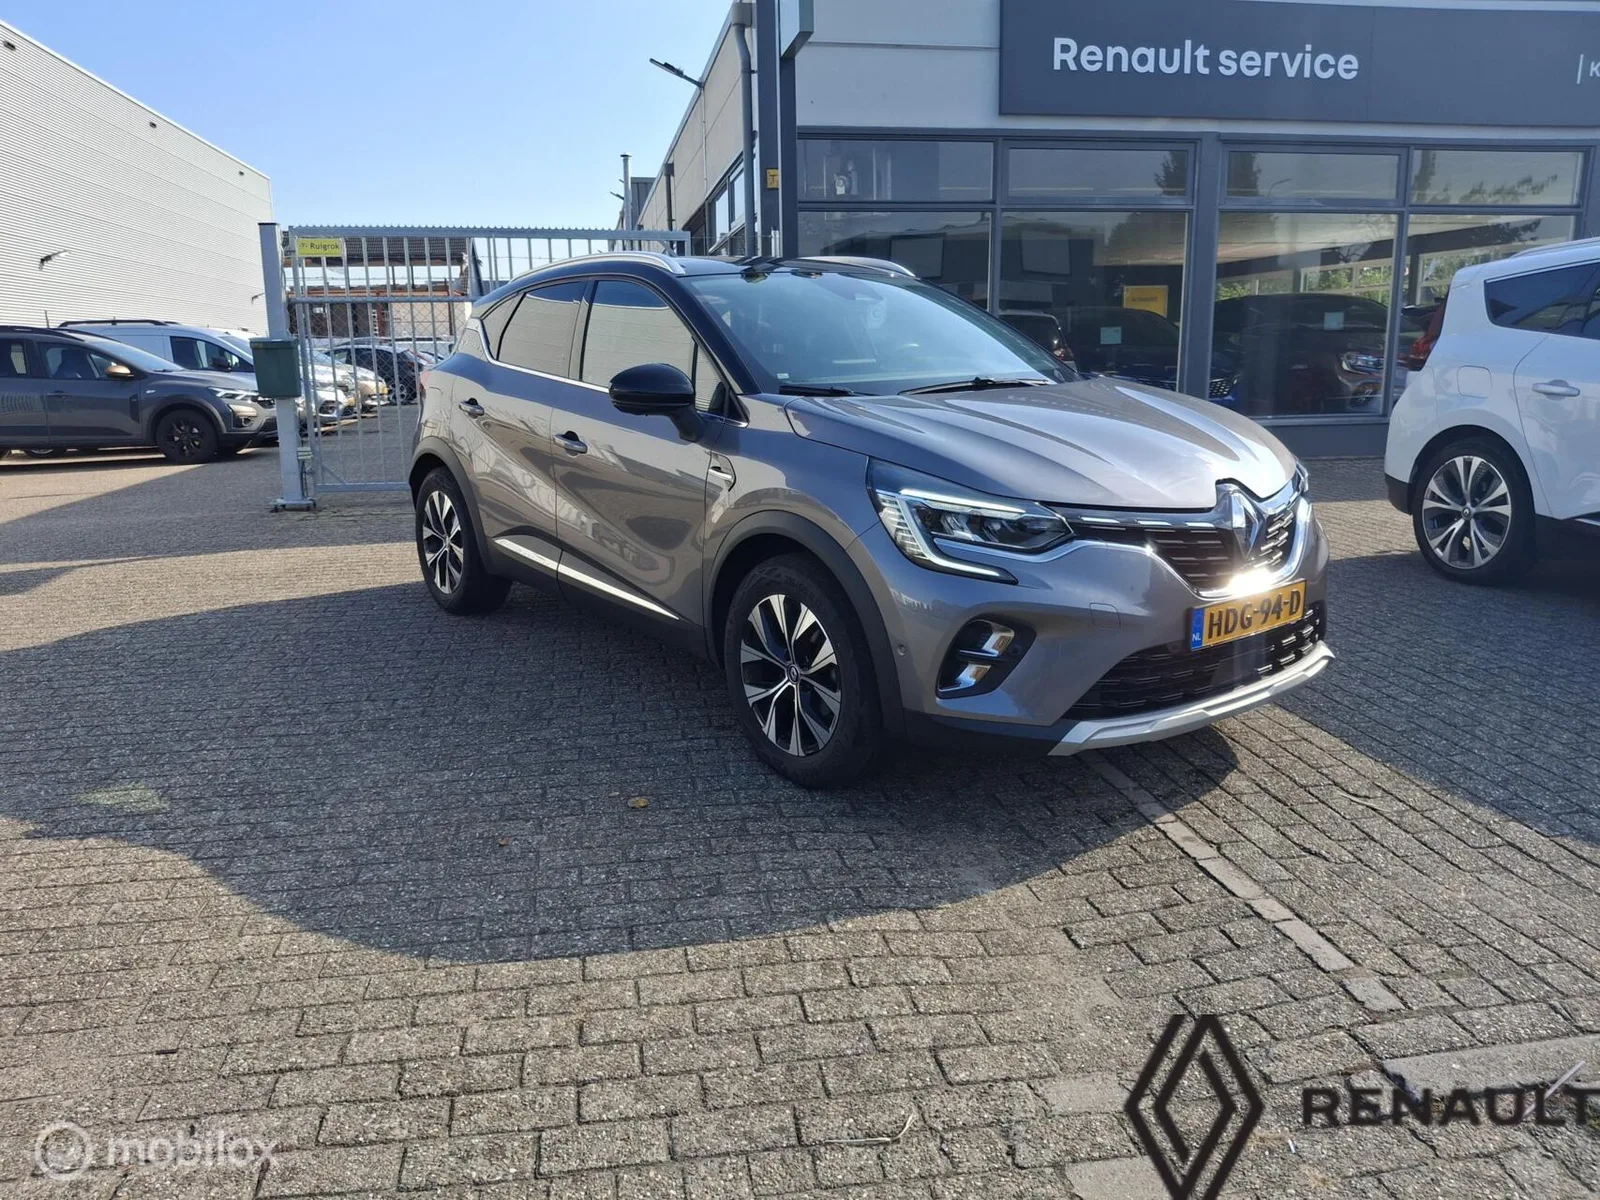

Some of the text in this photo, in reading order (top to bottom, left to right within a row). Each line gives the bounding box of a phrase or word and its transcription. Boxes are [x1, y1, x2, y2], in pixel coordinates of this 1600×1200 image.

[1053, 37, 1359, 80] Renault service
[1208, 590, 1301, 639] HDG-94-D
[1192, 632, 1202, 642] NL
